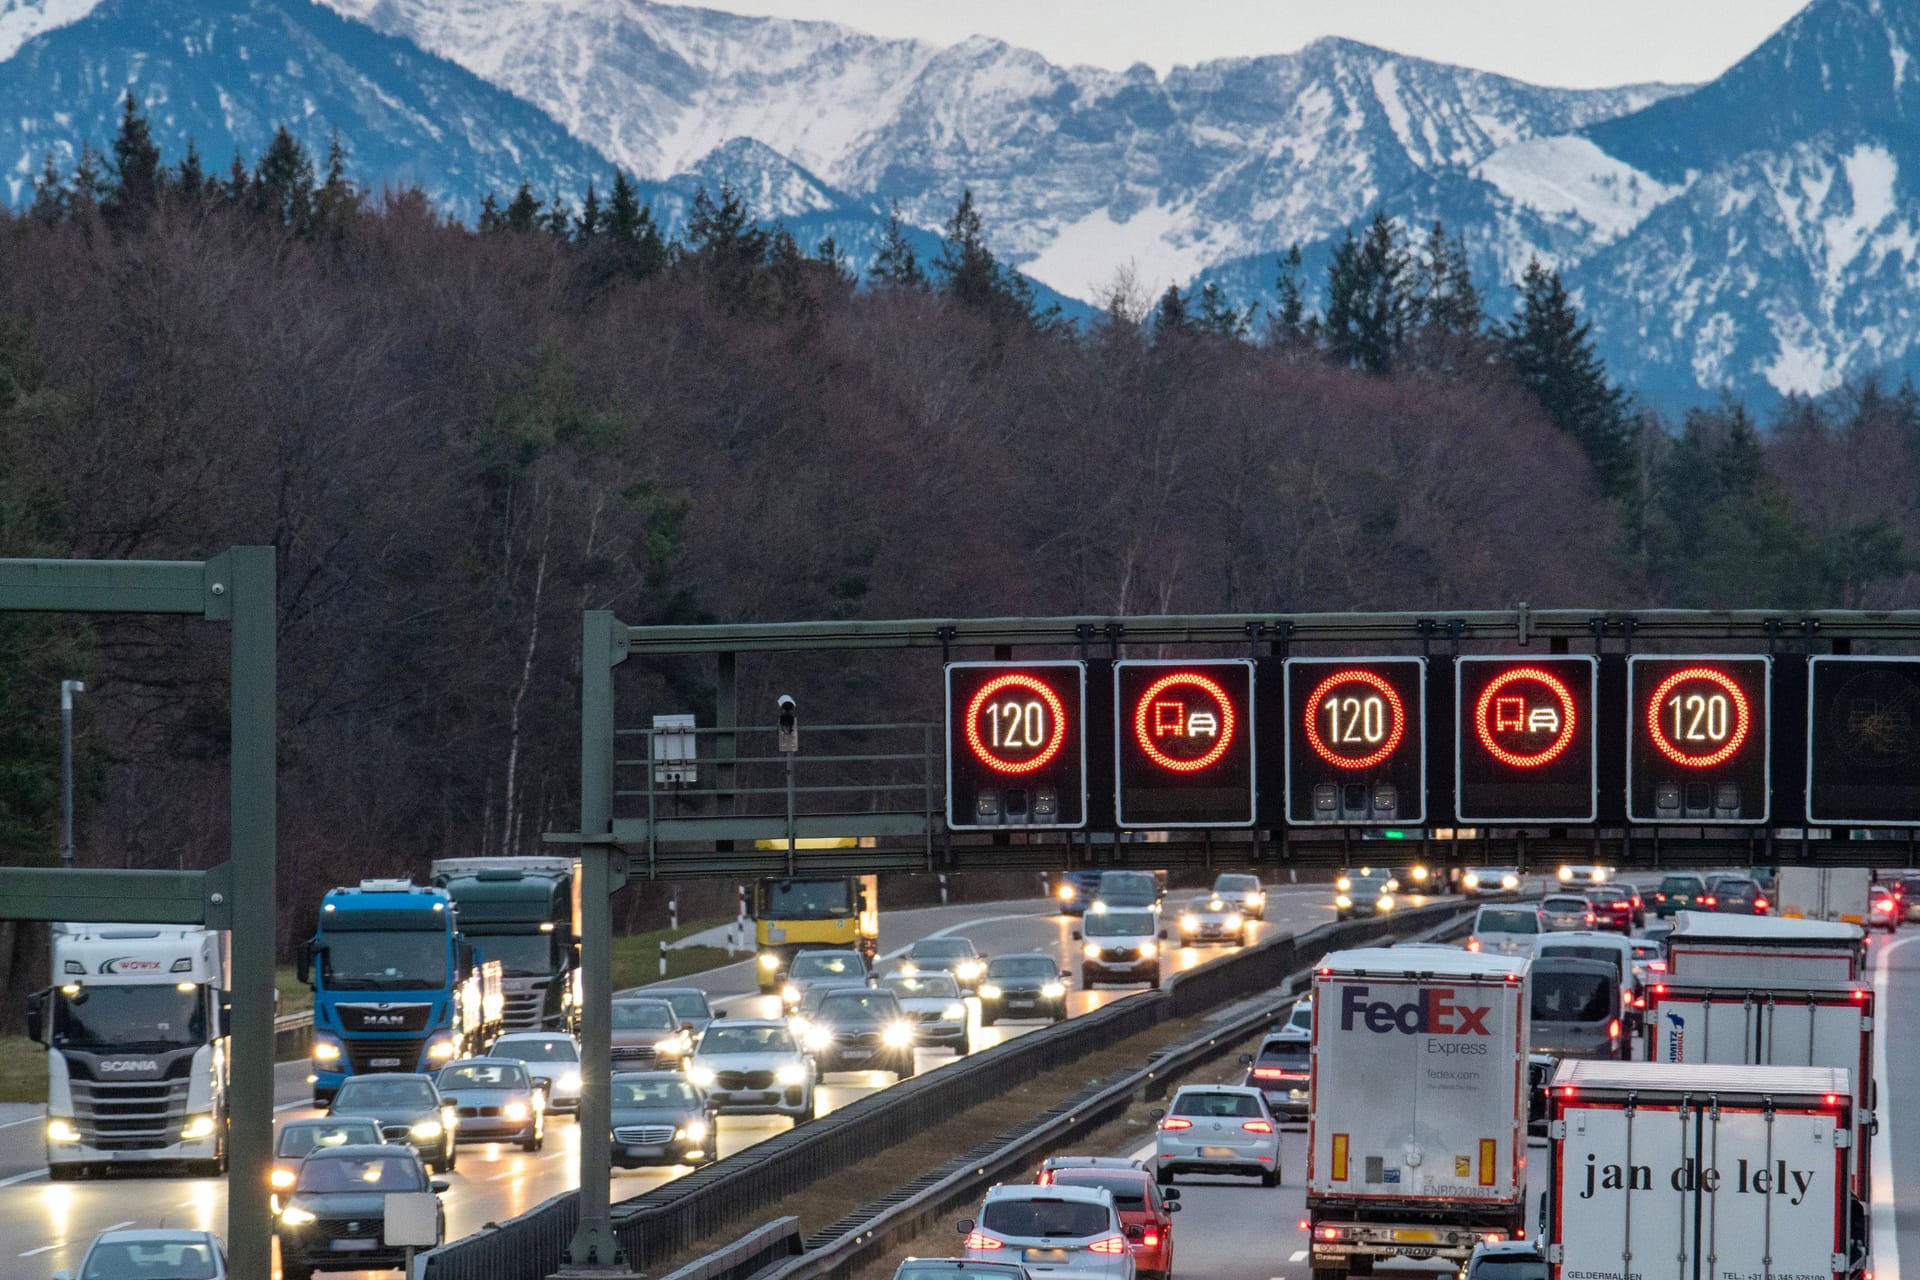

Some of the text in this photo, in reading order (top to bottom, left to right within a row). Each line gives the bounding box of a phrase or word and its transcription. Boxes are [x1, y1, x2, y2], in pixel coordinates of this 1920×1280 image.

[986, 702, 1043, 747] 120
[1324, 697, 1383, 743] 120
[1668, 694, 1727, 740] 120
[363, 1015, 405, 1025] MAN
[1341, 986, 1492, 1036] FedEx
[100, 1060, 158, 1072] SCANIA
[1427, 1039, 1488, 1057] Express
[1427, 1069, 1480, 1081] fedex.com
[1579, 1153, 1816, 1206] jan de lely
